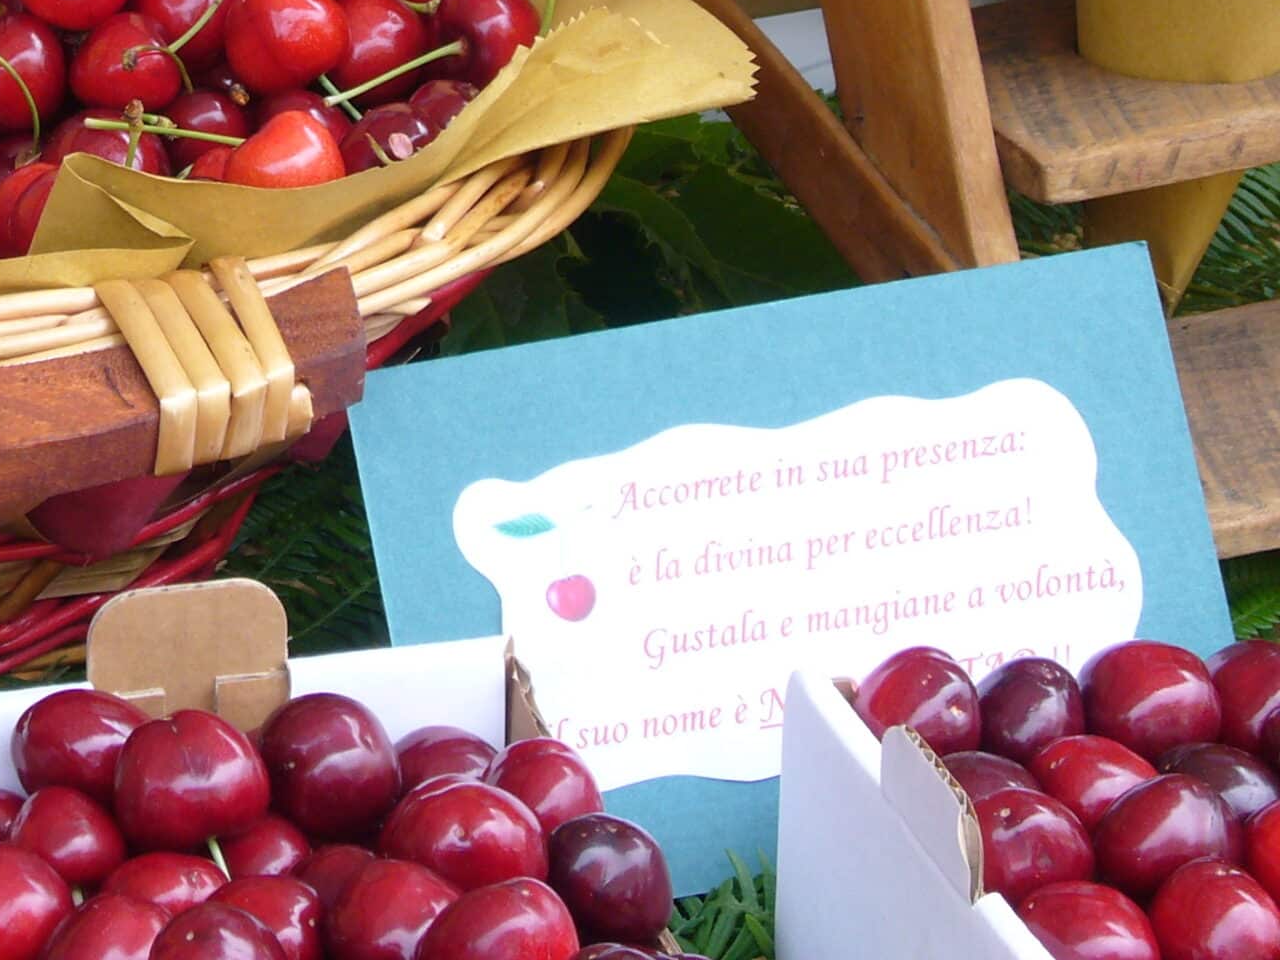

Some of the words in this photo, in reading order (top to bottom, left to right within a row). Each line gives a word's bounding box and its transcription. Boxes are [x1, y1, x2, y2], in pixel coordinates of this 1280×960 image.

[613, 470, 762, 519] Accorrete
[775, 458, 803, 489] in
[816, 455, 868, 482] sua
[881, 430, 1026, 484] presenza:
[628, 556, 641, 586] è
[655, 547, 681, 582] la
[694, 539, 792, 576] divina
[807, 531, 855, 571] per
[865, 496, 1032, 550] eccellenza!
[643, 609, 767, 670] Gustala
[780, 616, 793, 638] e
[807, 589, 956, 635] mangiane
[967, 586, 985, 609] a
[995, 559, 1126, 604] volontà,
[575, 722, 629, 750] suo
[643, 707, 722, 739] nome
[734, 694, 748, 725] è
